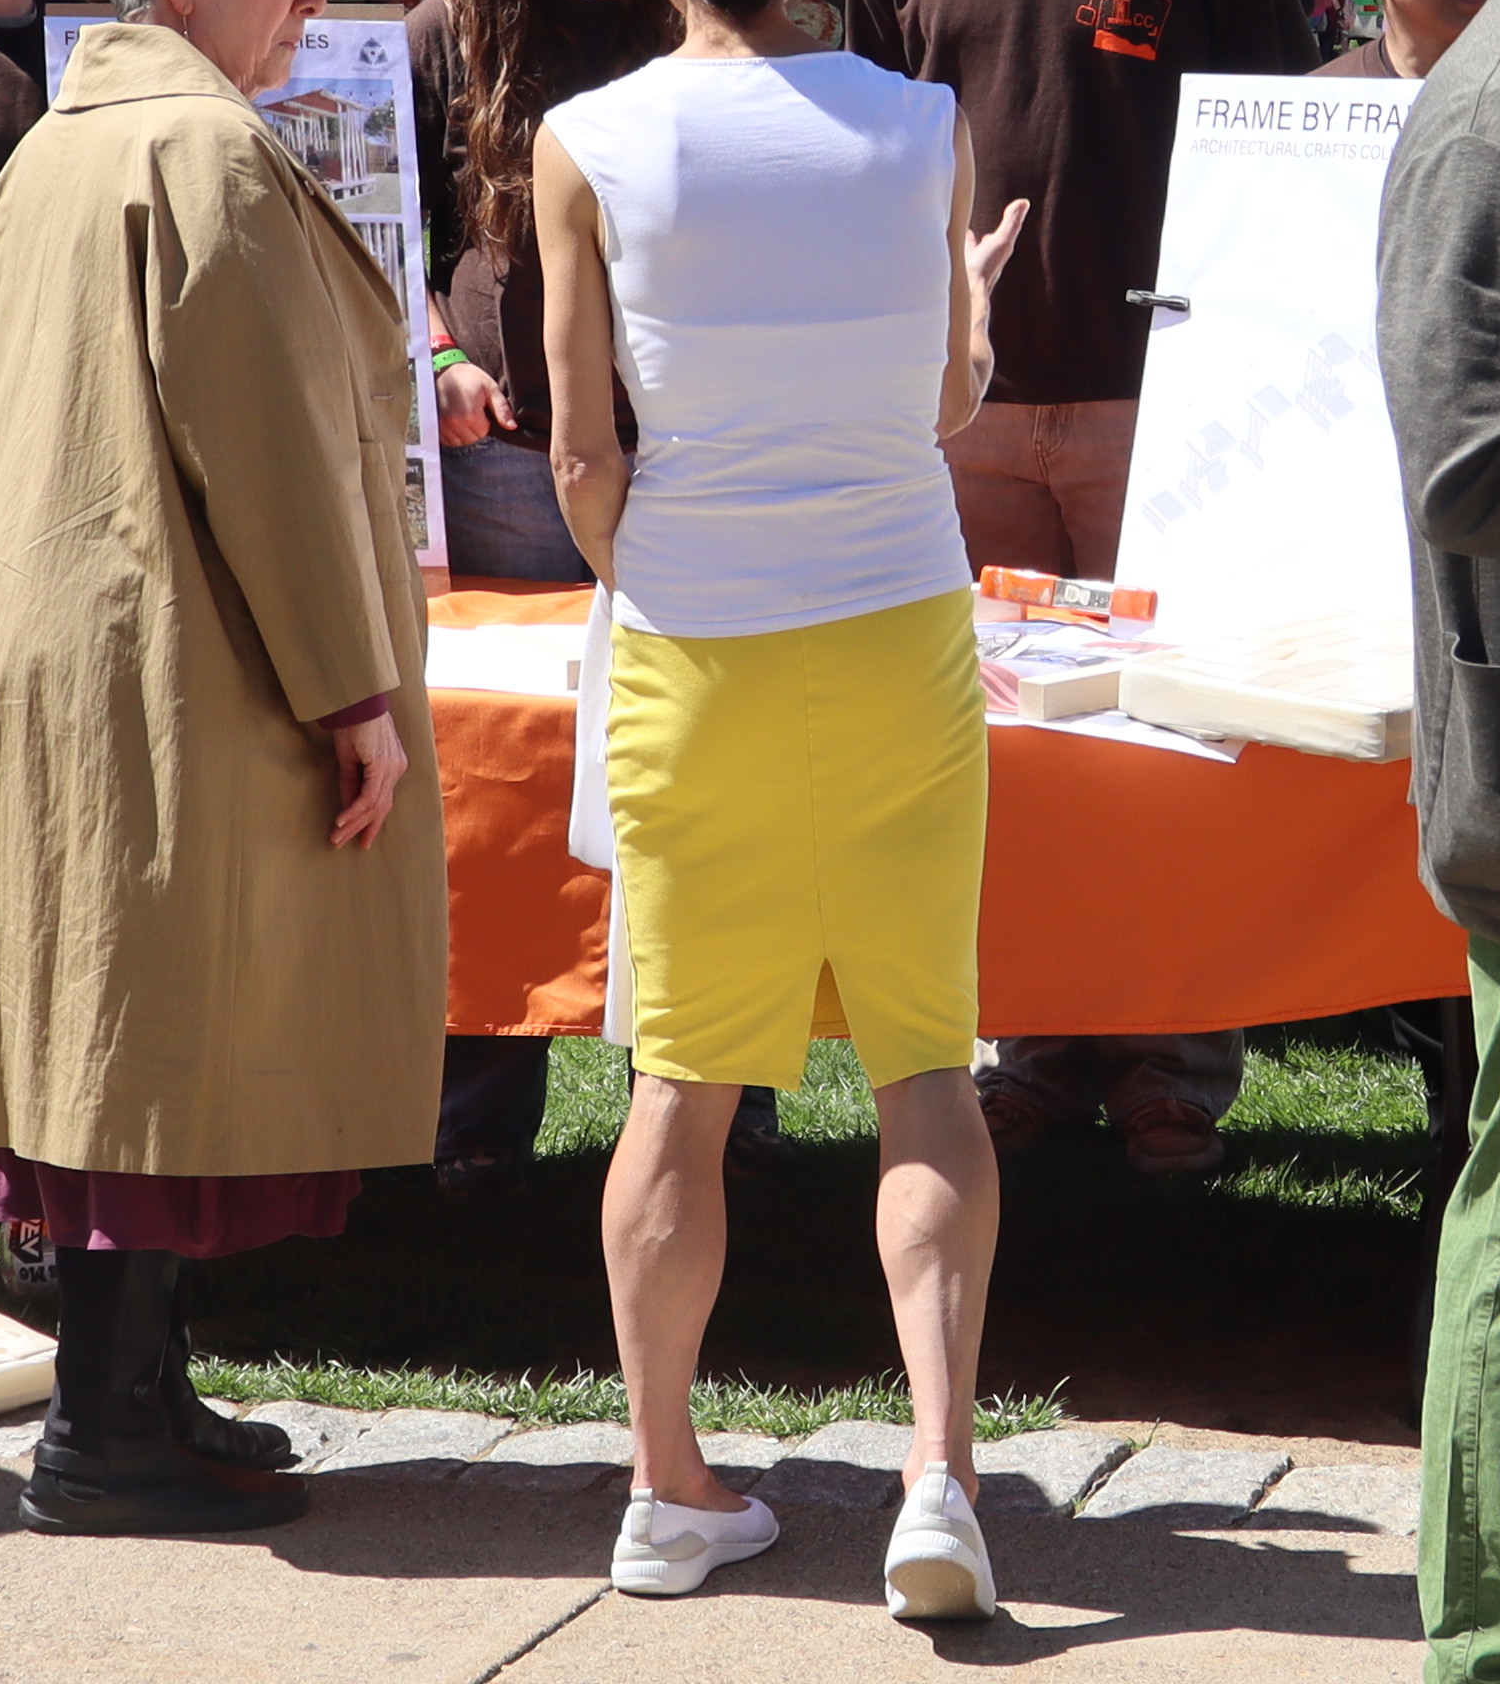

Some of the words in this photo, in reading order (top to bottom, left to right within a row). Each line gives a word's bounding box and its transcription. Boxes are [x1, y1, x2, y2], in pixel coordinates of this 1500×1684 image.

[1195, 99, 1294, 131] FRAME
[1302, 102, 1340, 132] BY
[1346, 103, 1413, 134] FRA
[1189, 138, 1301, 158] ARCHITECTURAL
[1304, 142, 1357, 160] CRAFTS
